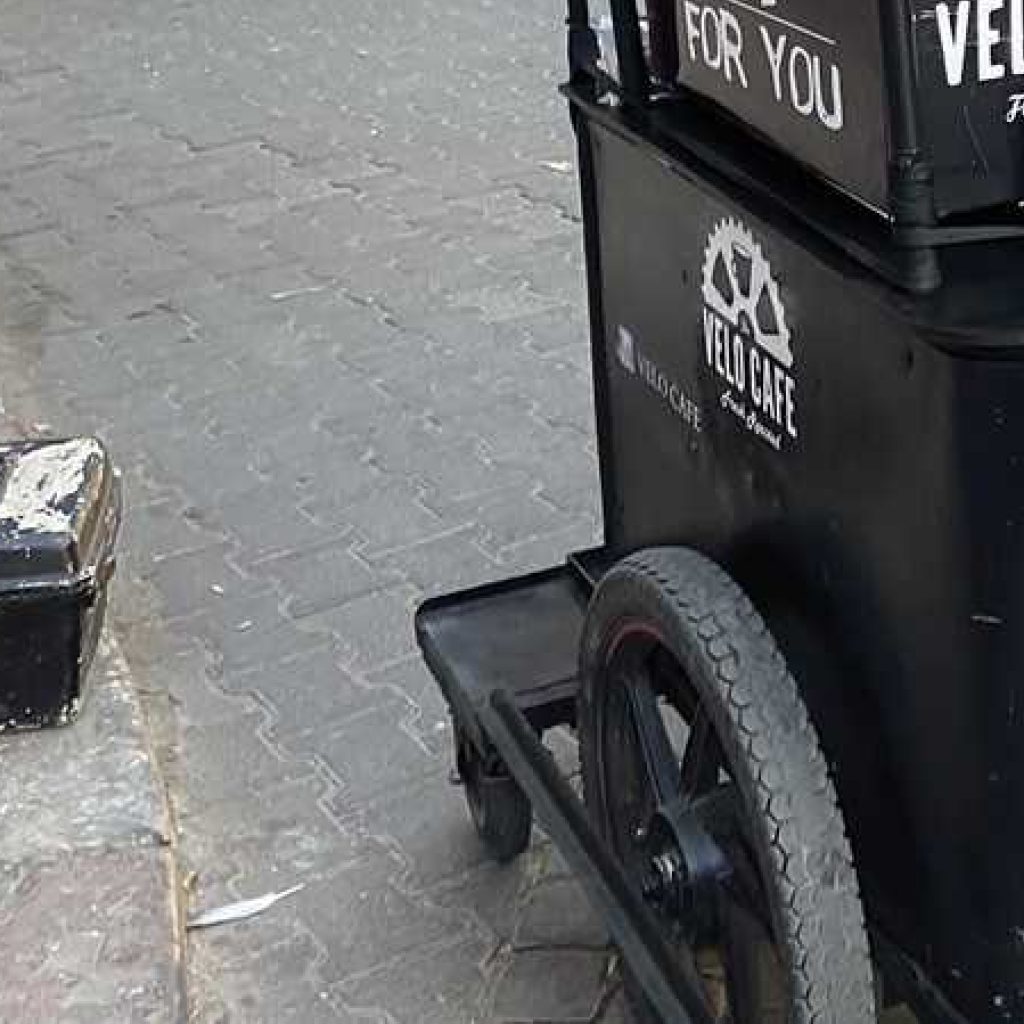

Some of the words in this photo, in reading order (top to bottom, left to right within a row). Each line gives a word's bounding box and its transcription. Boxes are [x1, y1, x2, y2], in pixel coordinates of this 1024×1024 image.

[684, 0, 749, 89] FOR
[758, 25, 845, 131] YOU
[703, 305, 746, 394] VELO
[750, 346, 798, 438] CAFE
